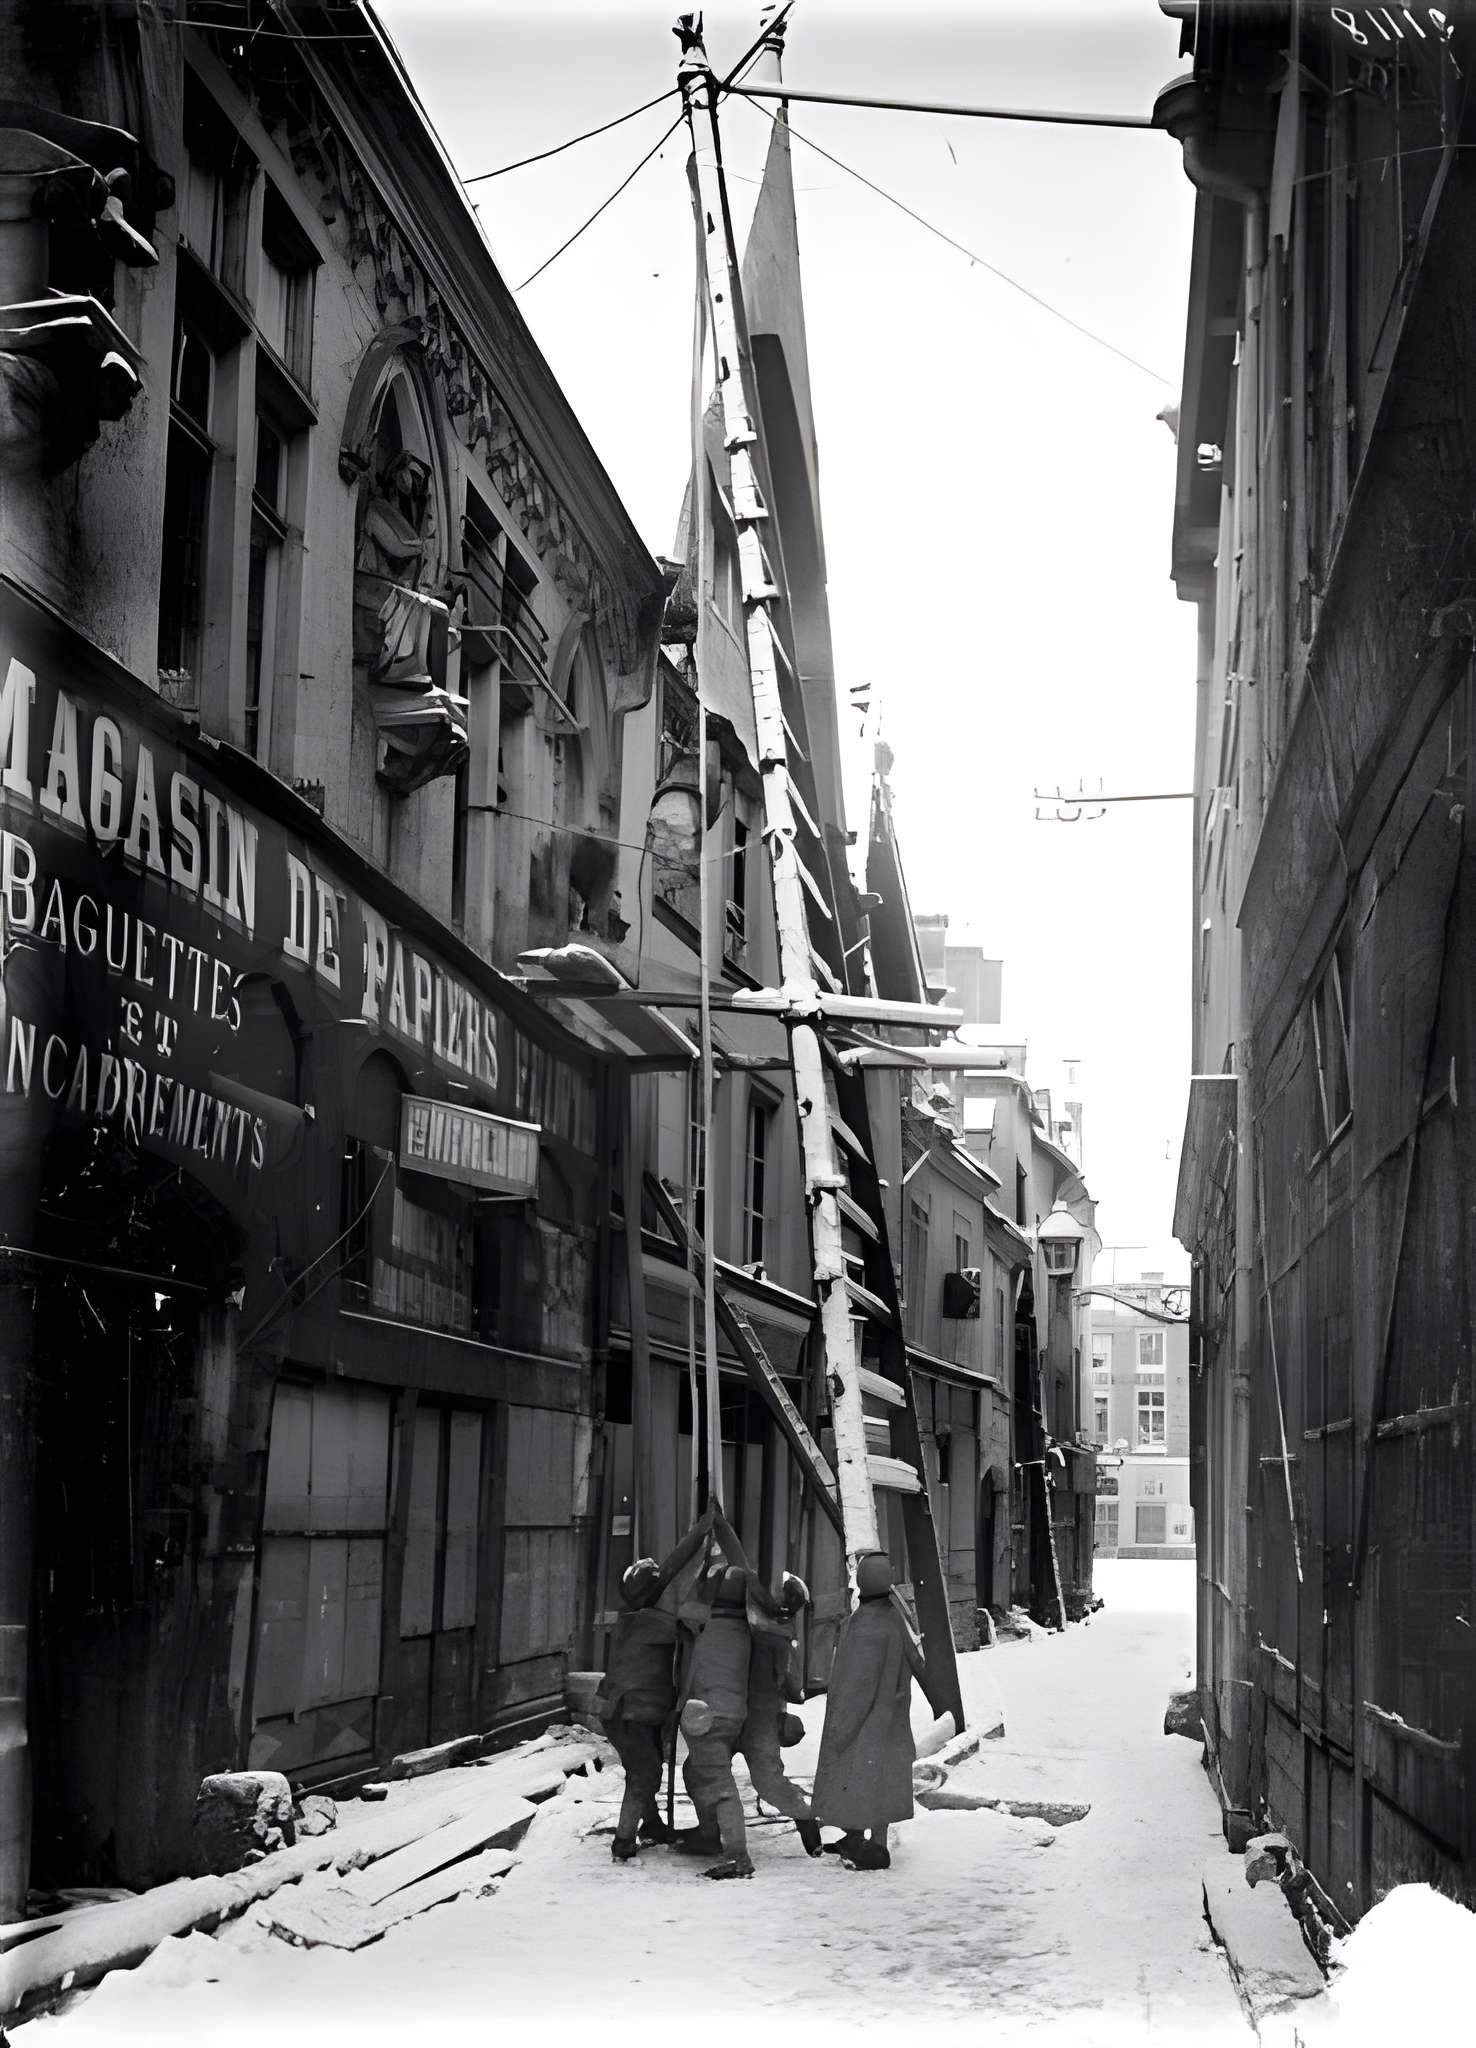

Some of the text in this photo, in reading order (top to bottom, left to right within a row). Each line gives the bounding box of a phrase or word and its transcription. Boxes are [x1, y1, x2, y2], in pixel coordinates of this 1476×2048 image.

[1, 829, 248, 1031] BAGUETTES
[283, 851, 347, 989] DE
[6, 1015, 264, 1170] NCADREMENTS
[121, 998, 178, 1057] ET
